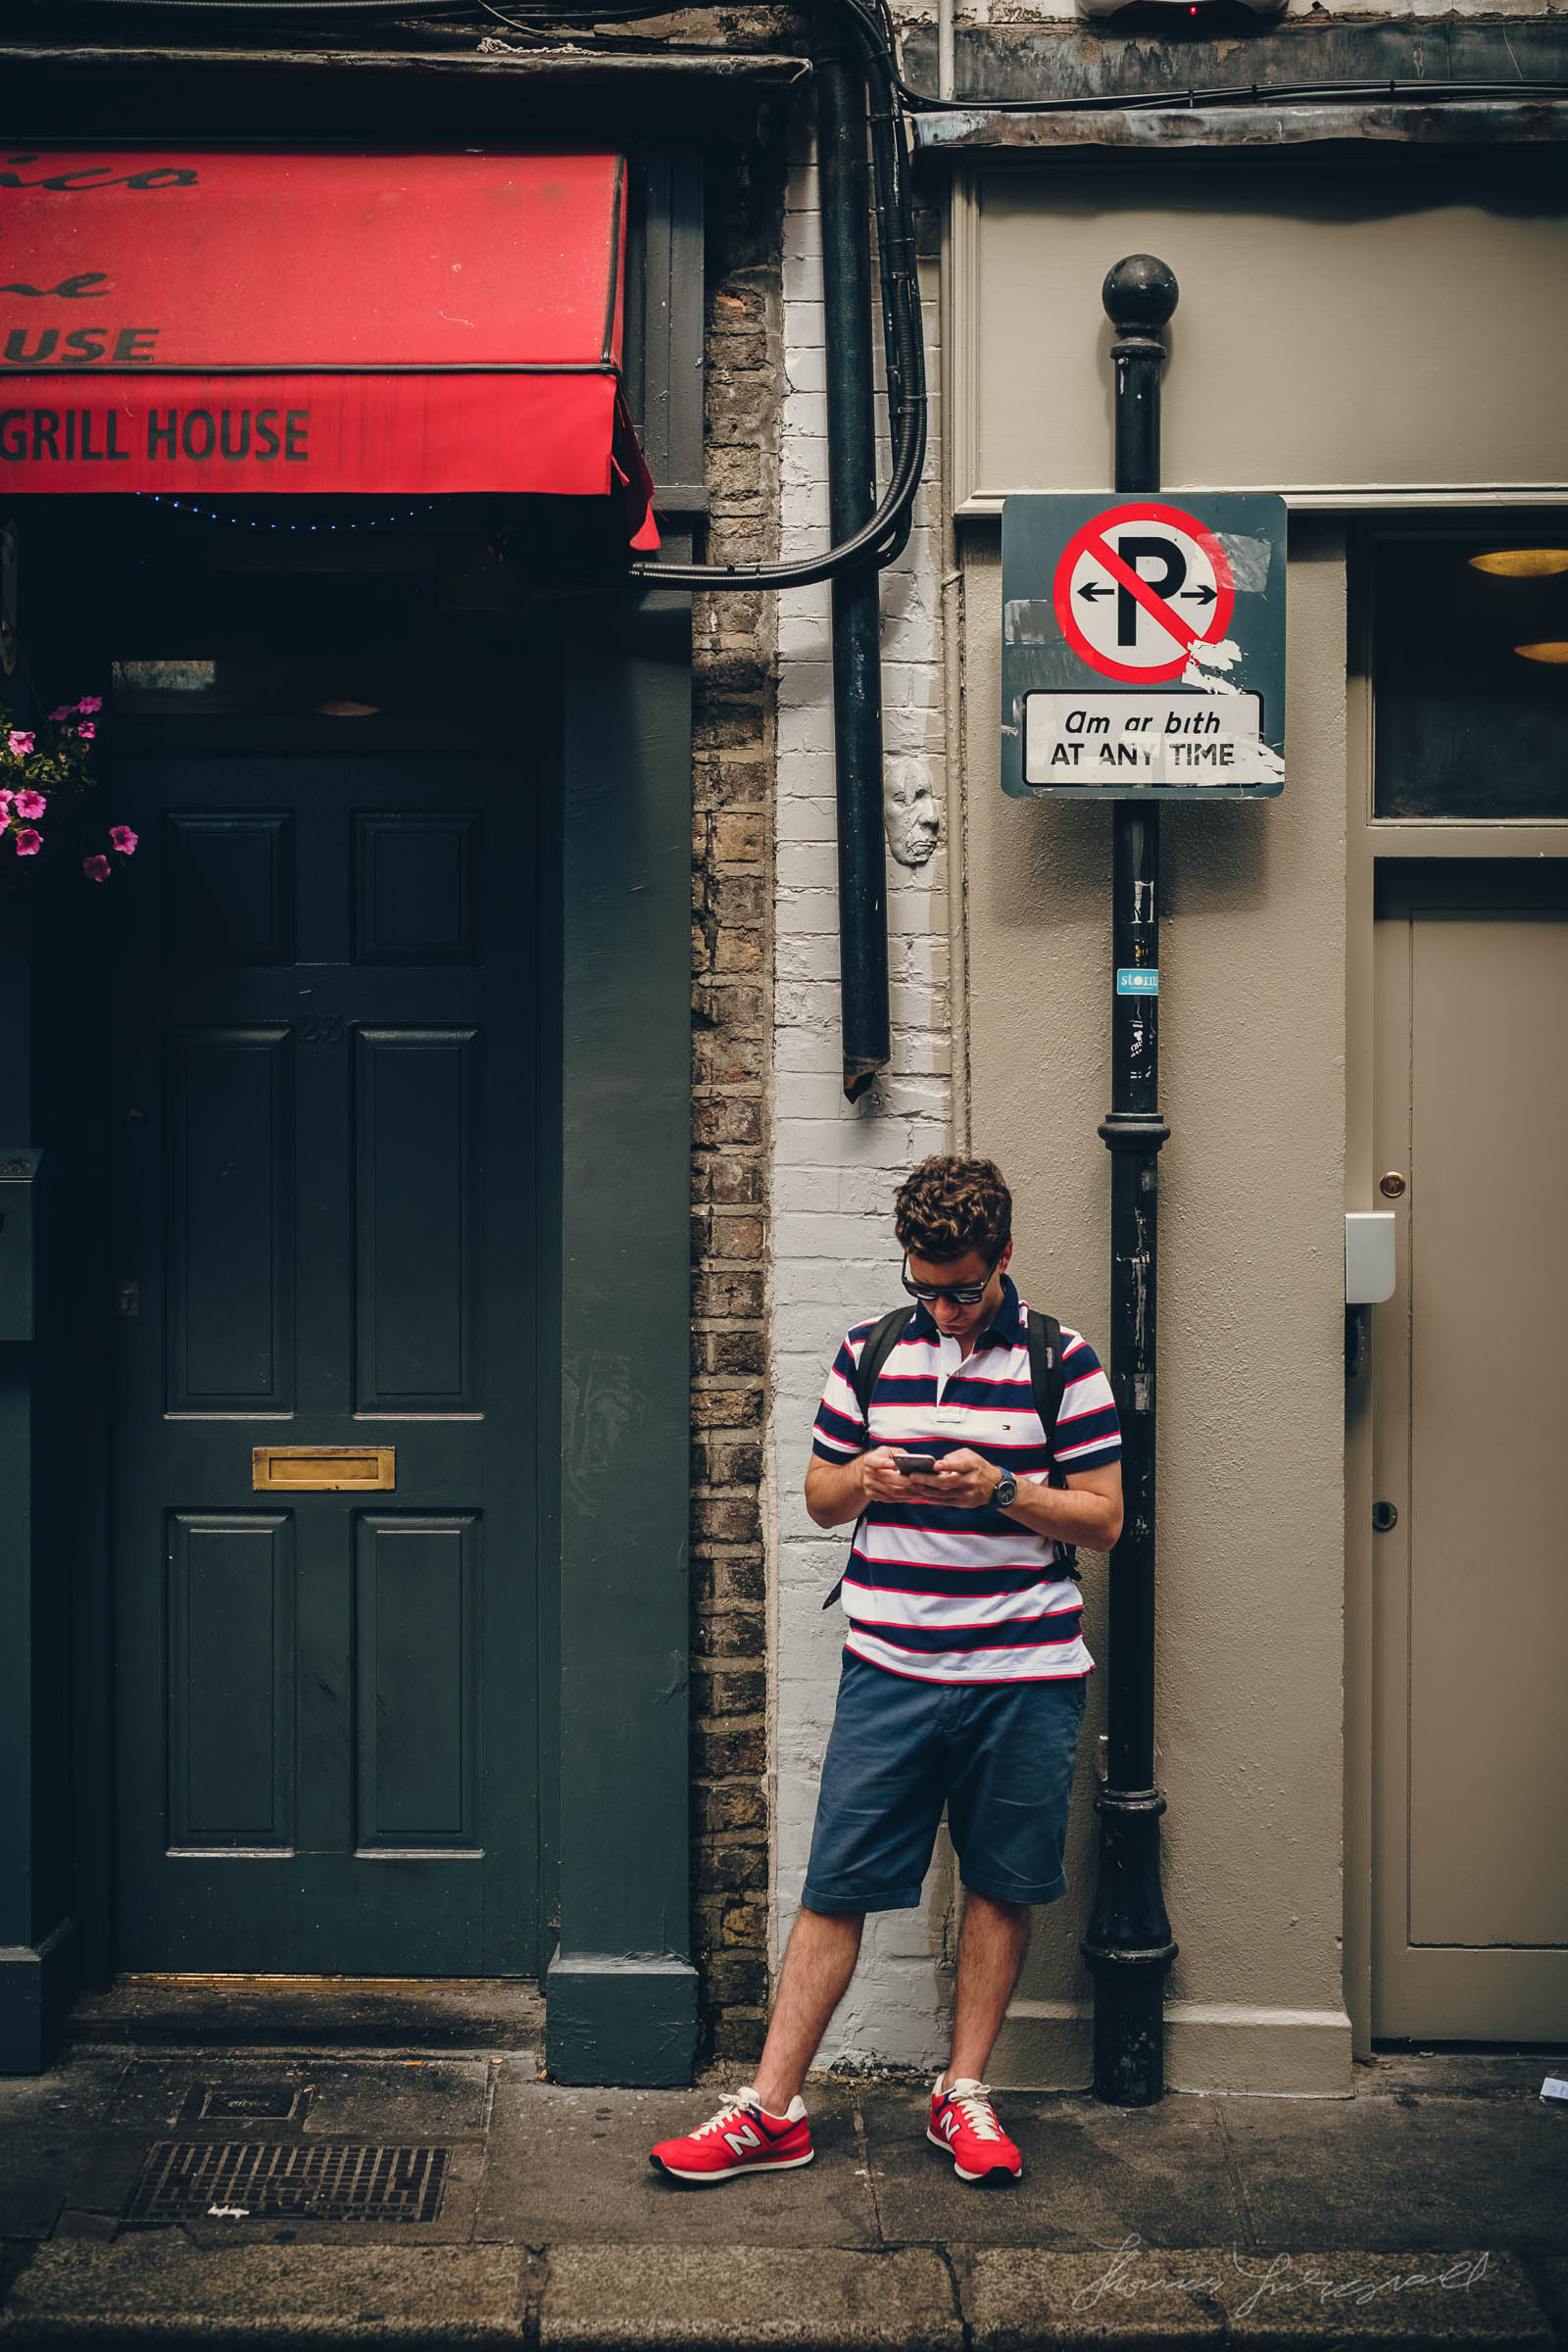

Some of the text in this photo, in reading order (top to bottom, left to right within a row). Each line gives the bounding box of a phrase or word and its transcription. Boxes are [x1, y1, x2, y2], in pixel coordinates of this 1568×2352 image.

[0, 409, 310, 463] GRILL HOUSE
[1118, 537, 1187, 647] P
[1051, 743, 1235, 766] AT ANY TIME
[723, 2124, 761, 2157] N
